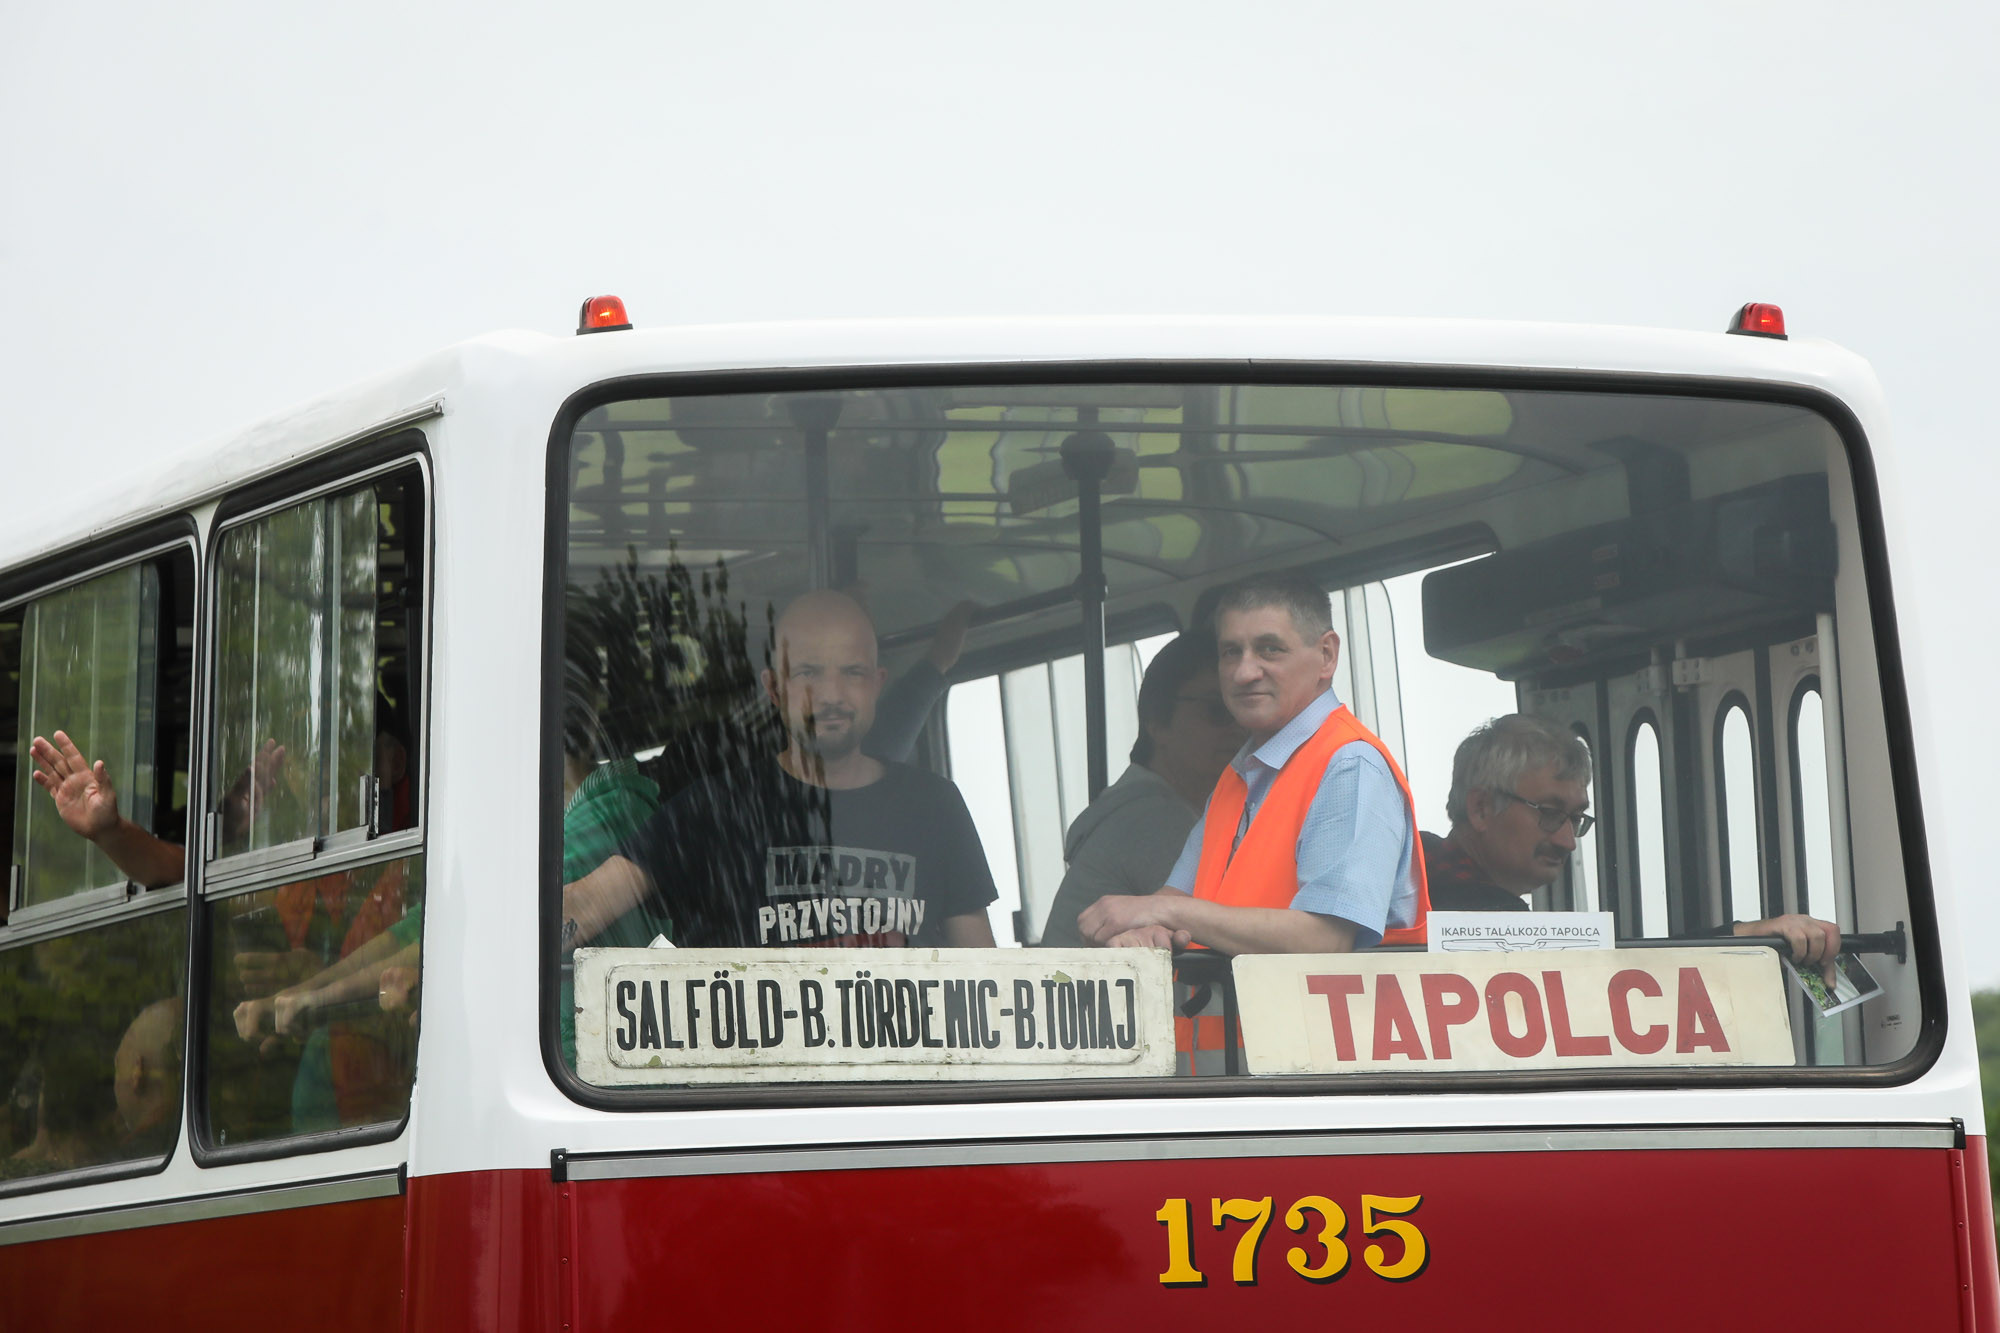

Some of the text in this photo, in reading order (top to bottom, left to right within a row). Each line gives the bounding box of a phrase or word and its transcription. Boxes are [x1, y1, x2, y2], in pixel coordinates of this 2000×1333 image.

[758, 896, 926, 945] PRZYSTOJNY
[1441, 924, 1600, 937] IKARUS TALÁLKOZÓ TAPOLCA
[1306, 966, 1732, 1062] TAPOLCA
[1155, 1194, 1430, 1288] 1735
